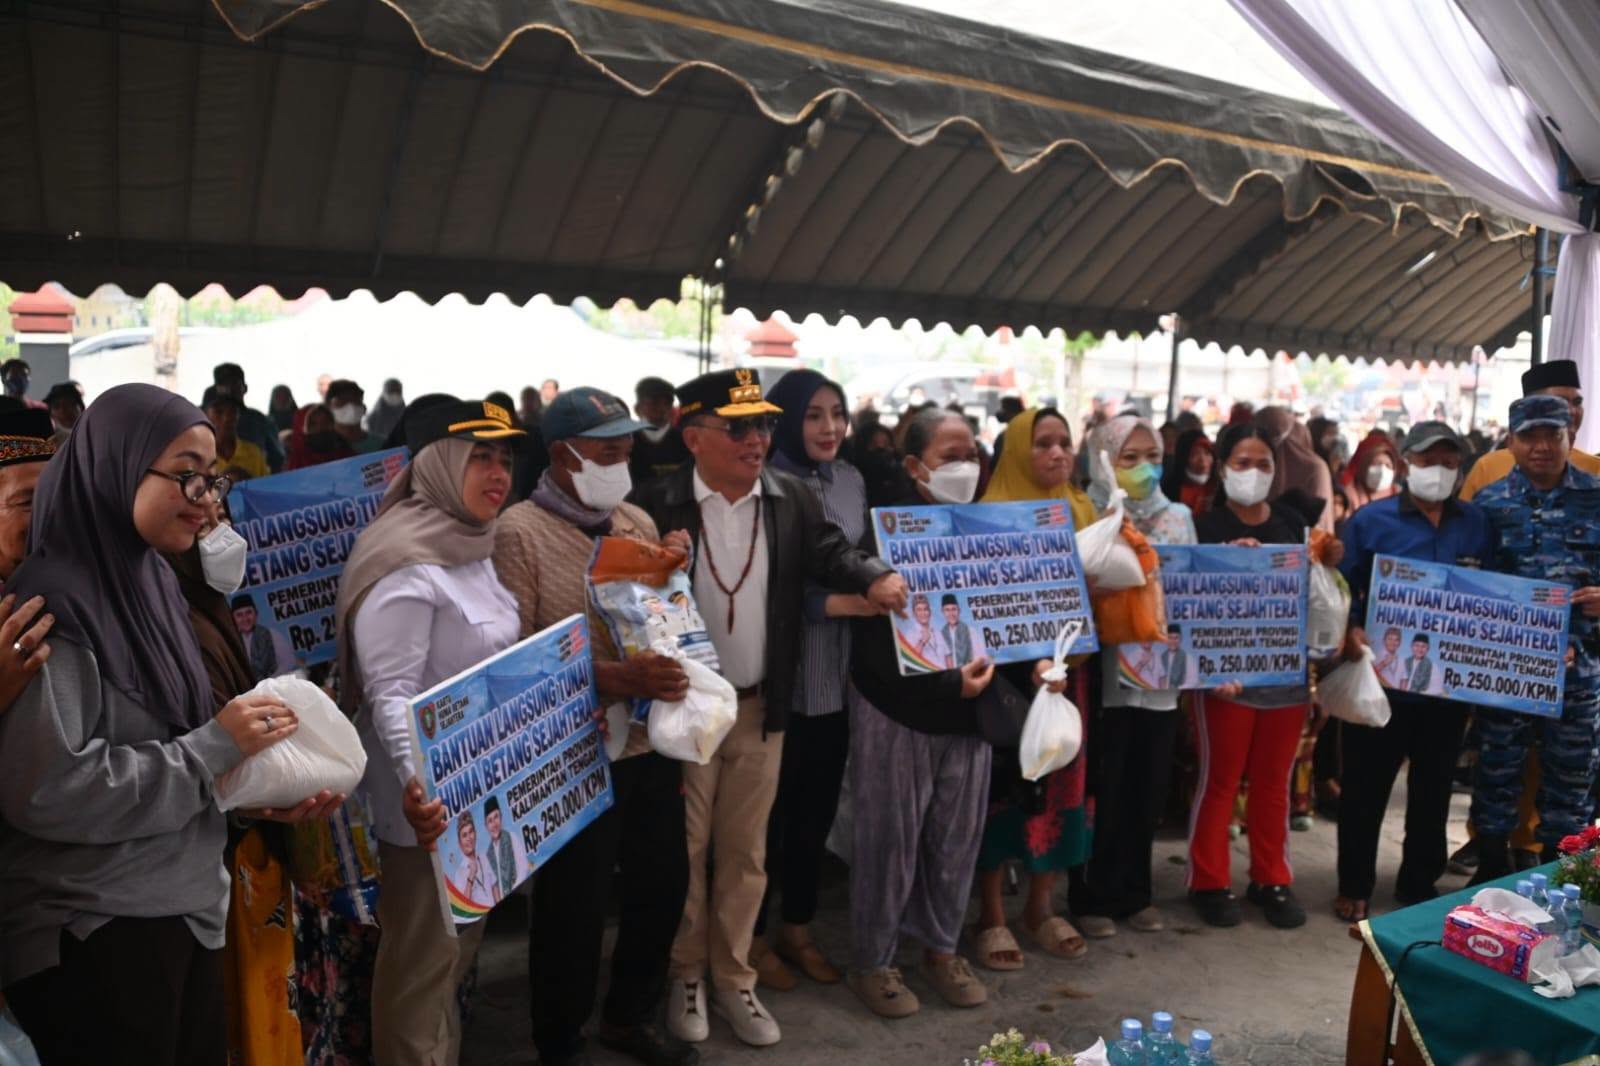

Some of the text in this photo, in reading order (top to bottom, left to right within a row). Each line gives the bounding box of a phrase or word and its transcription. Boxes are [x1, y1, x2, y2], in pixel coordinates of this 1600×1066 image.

[254, 499, 356, 550] LANGSUNG
[890, 530, 1071, 564] BANTUAN LANGSUNG TUNAI
[944, 561, 998, 589] BETANG
[1001, 555, 1076, 586] SEJAHTERA
[1193, 574, 1260, 595] LANGSUNG
[1264, 574, 1299, 595] TUNAI
[267, 577, 339, 606] PEMERINT
[274, 594, 337, 621] KALIMAN
[968, 587, 1080, 607] PEMERINTAH PROVINSI
[1378, 583, 1443, 610] BANTUAN
[1446, 592, 1519, 622] LANGSUNG
[1523, 606, 1562, 630] TUNAI
[972, 600, 1081, 621] KALIMANTAN TENGAH
[1172, 599, 1298, 620] BETANG SEJAHTERA
[983, 627, 1004, 650] Rp.
[1376, 605, 1558, 652] HUMA BETANG SEJAHTERA
[1199, 654, 1300, 676] Rp. 250.000/KPM
[1439, 641, 1557, 668] PEMERINTAH PROVINSI
[1439, 652, 1556, 679] KALIMANTAN TENGAH
[1444, 668, 1558, 702] Rp. 250.000/KPM
[430, 658, 590, 783] BANTUAN LANGSUNG TUNAI
[483, 733, 531, 790] BETANG
[532, 694, 592, 756] SEJAHTERA
[507, 756, 561, 801] PEMERINTAH
[511, 774, 567, 822] KALIMANTAN
[522, 766, 607, 852] Rp. 250.000/KPM
